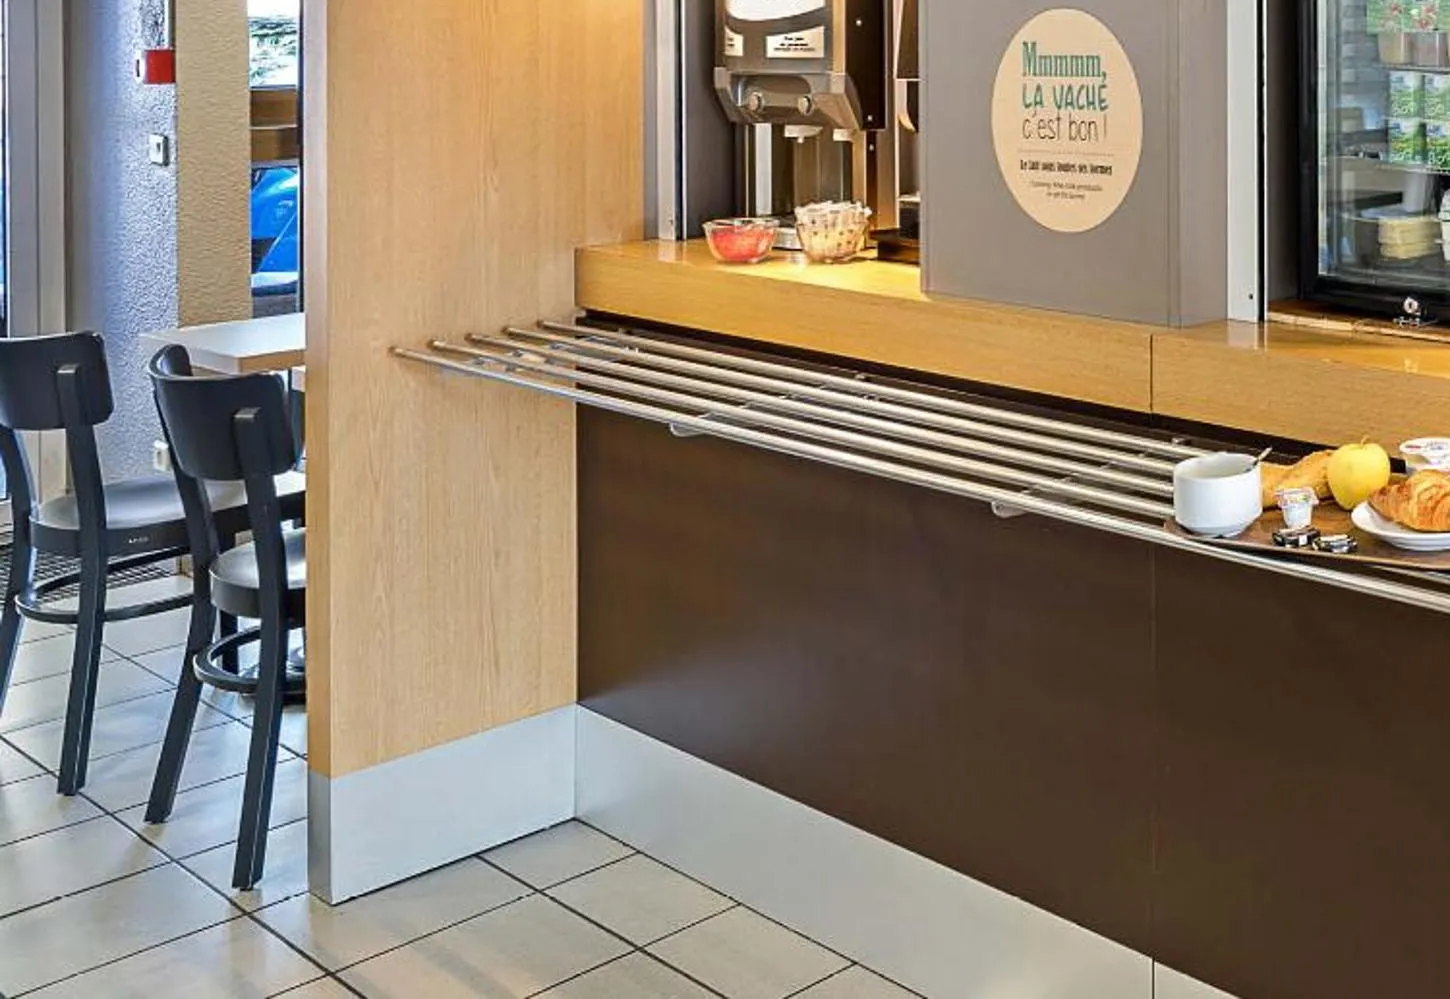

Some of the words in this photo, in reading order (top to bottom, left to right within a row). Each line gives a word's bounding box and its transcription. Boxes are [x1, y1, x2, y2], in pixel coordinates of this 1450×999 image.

[1022, 84, 1045, 109] LA
[1053, 84, 1109, 111] VACHE
[1022, 112, 1062, 141] c'est
[1068, 113, 1099, 142] bon
